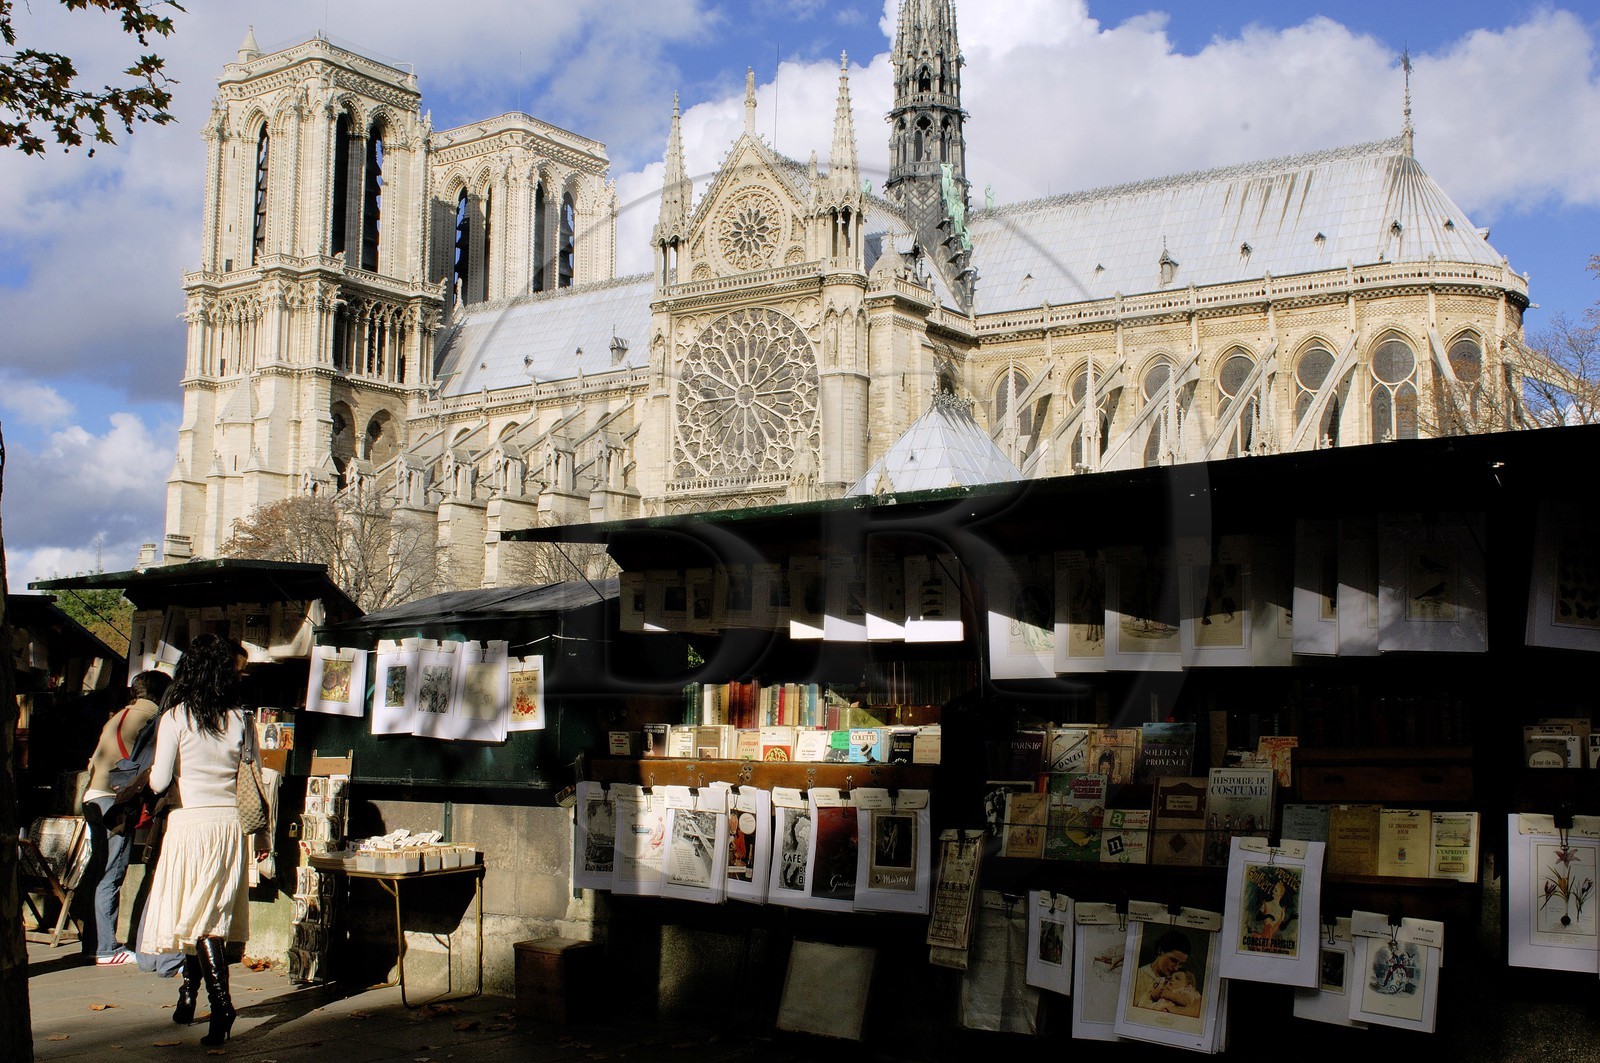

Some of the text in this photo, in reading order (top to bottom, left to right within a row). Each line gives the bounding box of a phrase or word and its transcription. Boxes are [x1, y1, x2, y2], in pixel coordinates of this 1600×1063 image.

[1011, 741, 1032, 749] PARIS
[1145, 758, 1187, 766] PROVENCE
[1213, 776, 1254, 784] HISTOIRE
[1211, 784, 1267, 796] COSTUME
[1247, 865, 1276, 895] Guilbert
[1269, 867, 1301, 890] Yvette
[1242, 936, 1295, 949] CONCERT PARISIEN
